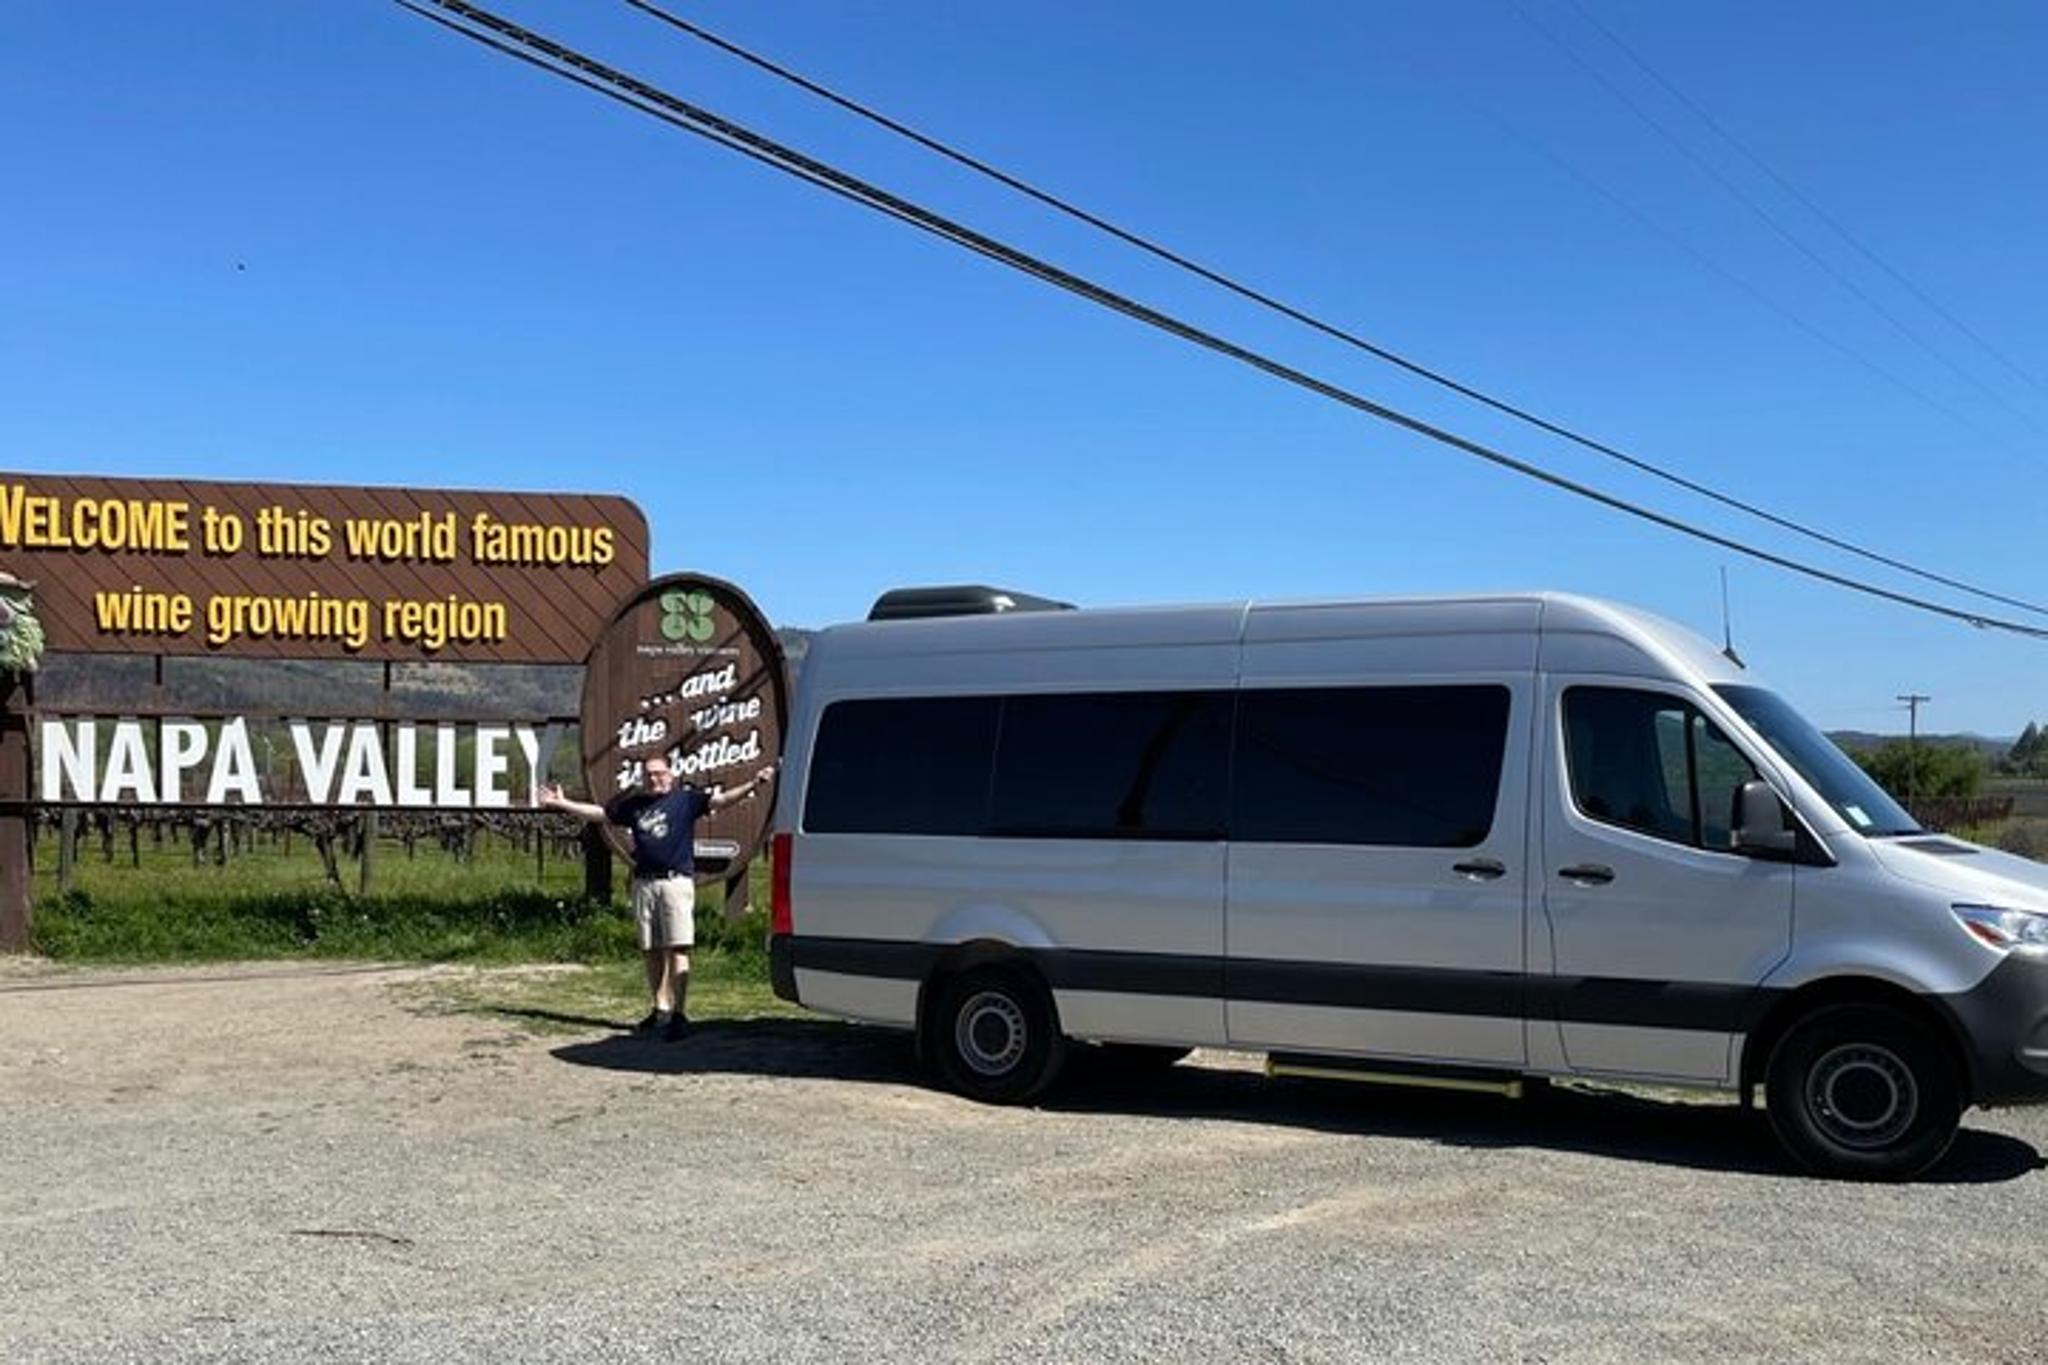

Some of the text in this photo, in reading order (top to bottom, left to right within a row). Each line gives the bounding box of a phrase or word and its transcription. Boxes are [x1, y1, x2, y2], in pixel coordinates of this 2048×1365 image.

[0, 485, 614, 565] WELCOME to this world famous
[97, 586, 506, 648] wine growing region
[618, 696, 760, 748] the wine
[41, 716, 562, 807] NAPA VALLEY
[669, 730, 760, 777] bottled
